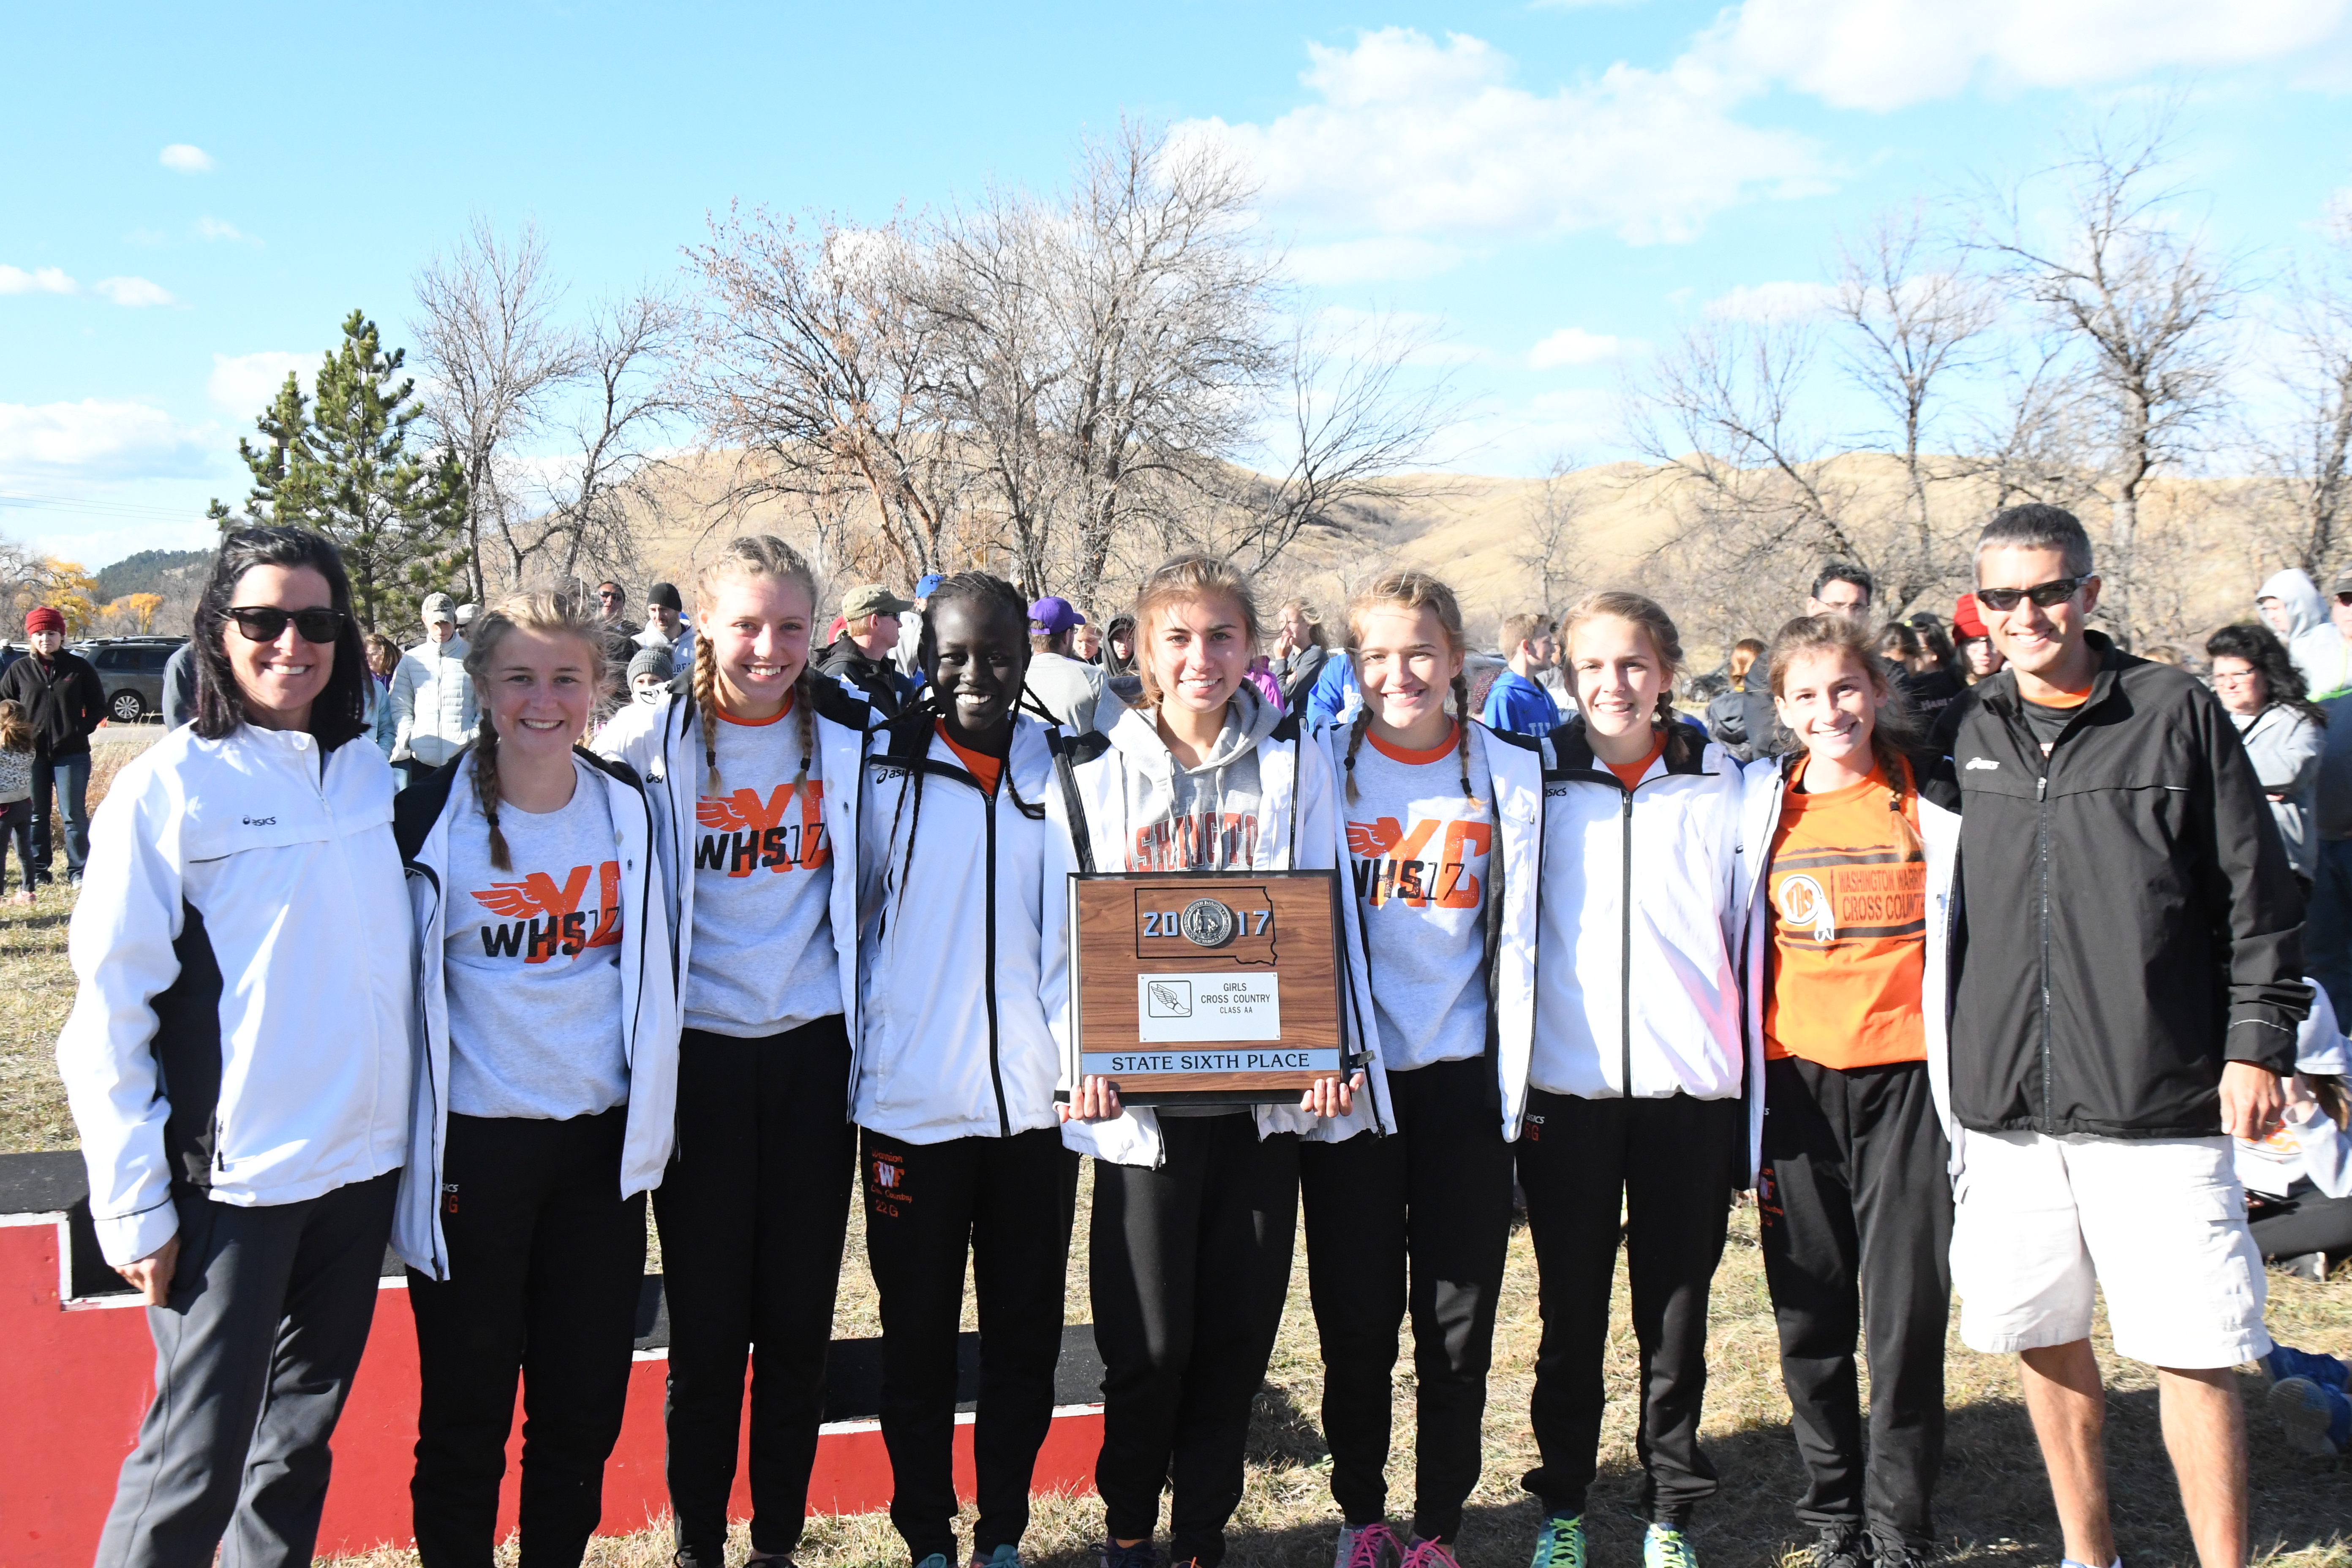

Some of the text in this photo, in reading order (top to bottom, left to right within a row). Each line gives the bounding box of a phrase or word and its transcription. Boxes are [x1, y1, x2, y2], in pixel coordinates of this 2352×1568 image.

[1369, 817, 1492, 909] XC
[1838, 869, 1894, 893] WASHINGTON
[1843, 895, 1883, 921] CROSS
[1223, 983, 1247, 991] GIRLS
[1201, 994, 1270, 1004] CROSS COUNTRY
[1112, 1053, 1309, 1071] STATE SIXTH PLACE
